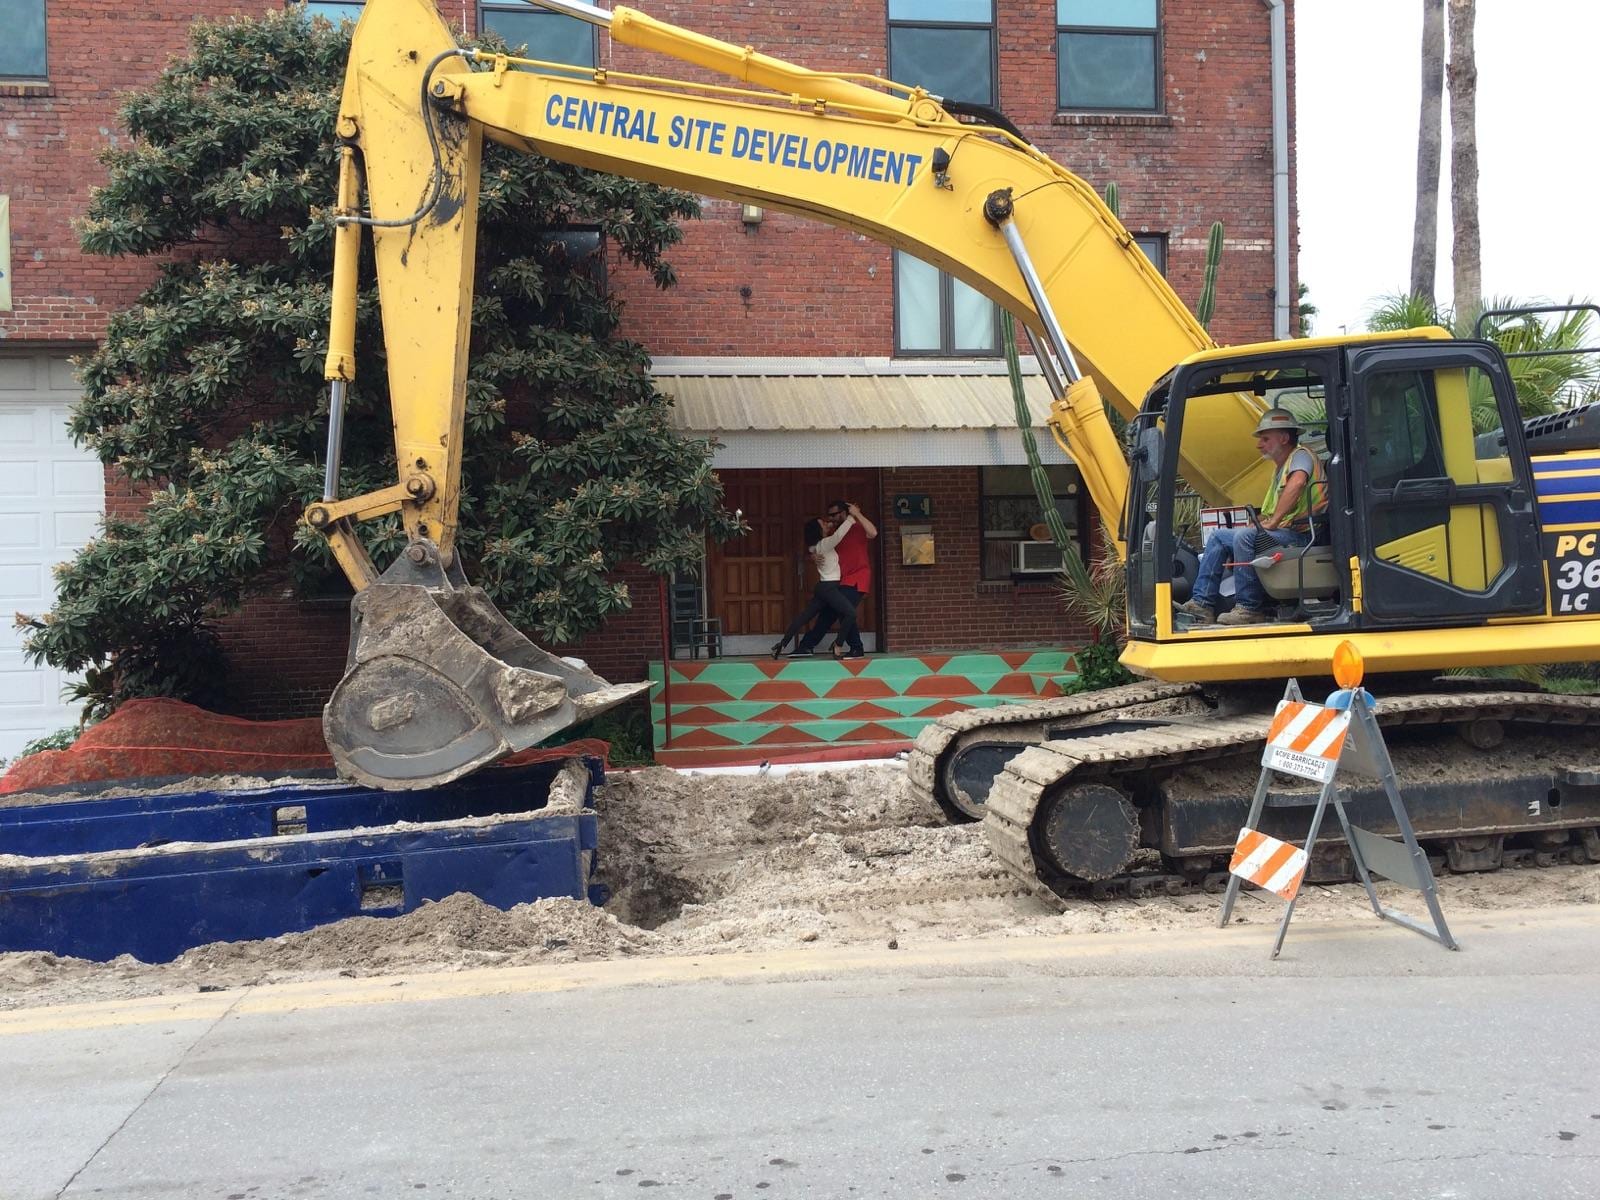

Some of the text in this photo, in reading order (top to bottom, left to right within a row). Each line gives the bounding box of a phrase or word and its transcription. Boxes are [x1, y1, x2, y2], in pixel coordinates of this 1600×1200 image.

[546, 94, 922, 186] CENTRAL SITE DEVELOPMENT
[1556, 533, 1597, 558] PC
[1559, 593, 1590, 612] LC
[1275, 750, 1326, 769] ACME BARRICADES
